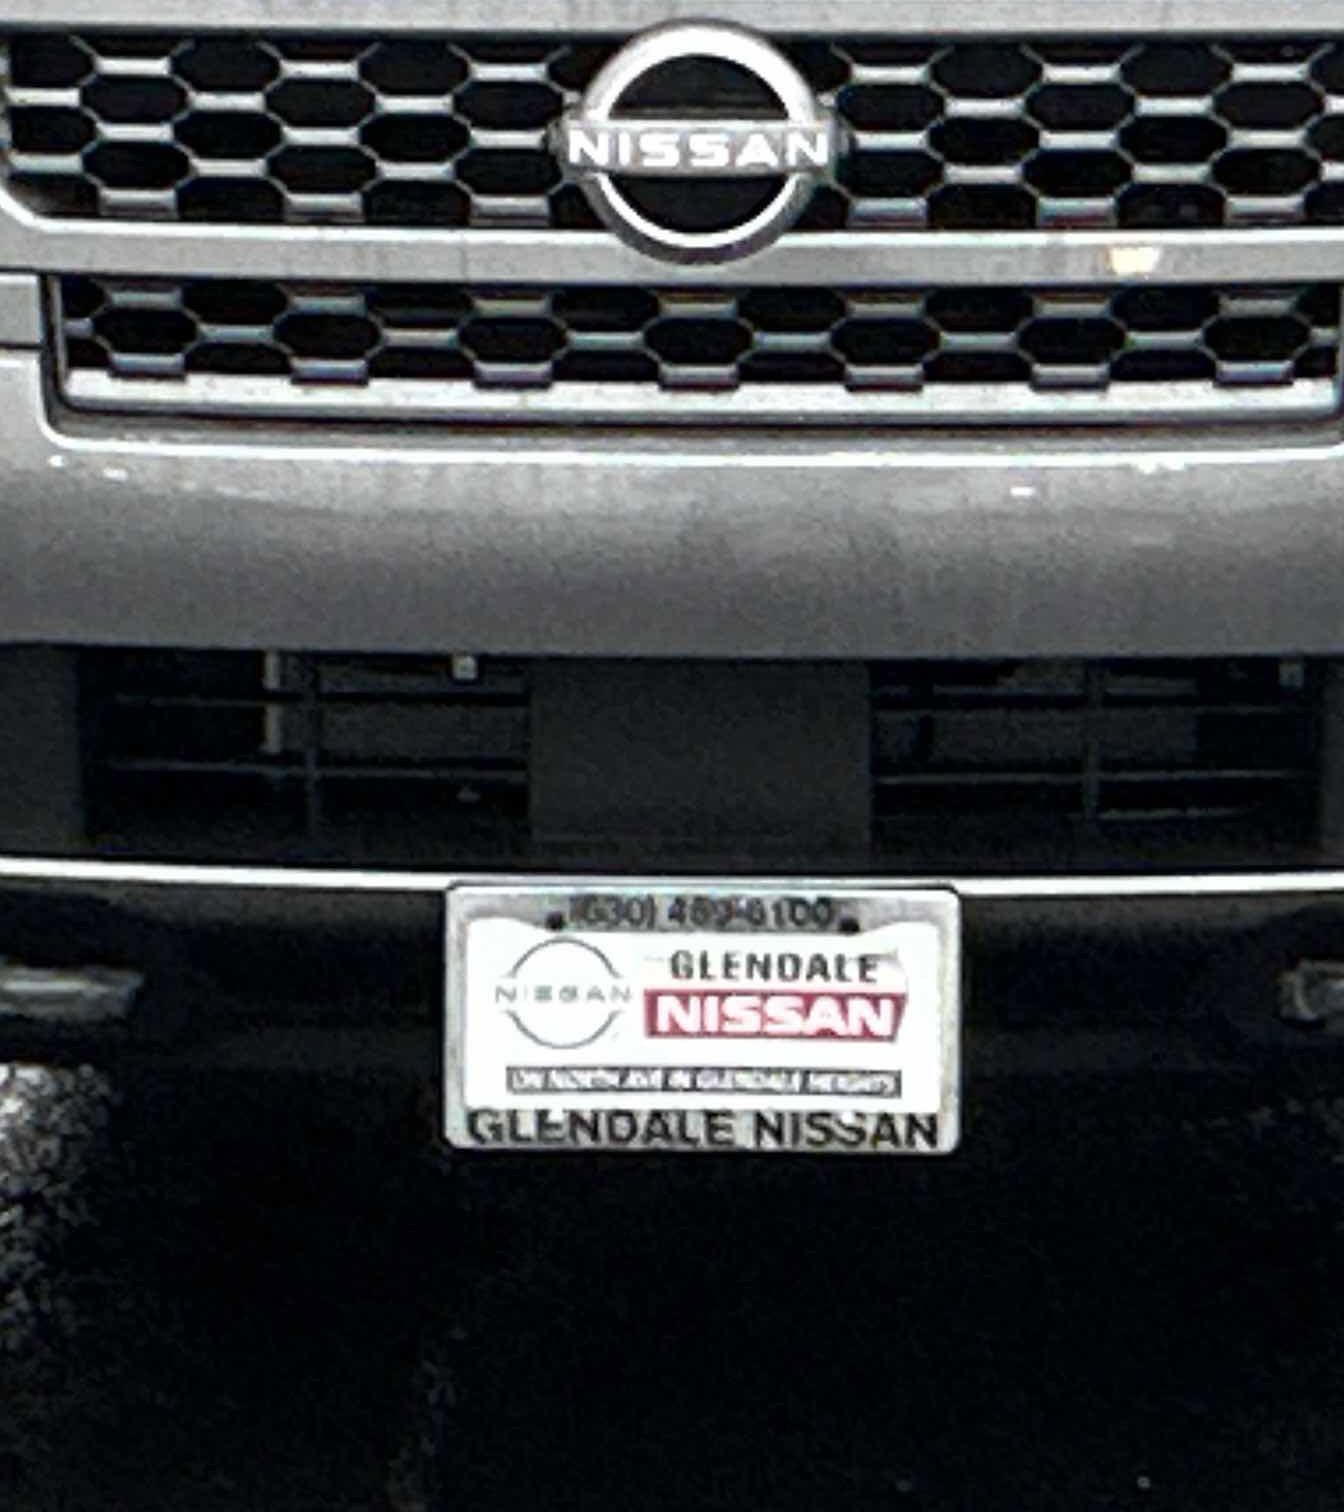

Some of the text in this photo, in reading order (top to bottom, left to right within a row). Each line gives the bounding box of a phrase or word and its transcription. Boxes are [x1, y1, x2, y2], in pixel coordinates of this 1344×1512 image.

[567, 128, 829, 168] NISSAN
[670, 949, 879, 983] GLENDALE
[655, 993, 895, 1038] NISSAN
[467, 1108, 940, 1148] GLENDALE NISSAN
